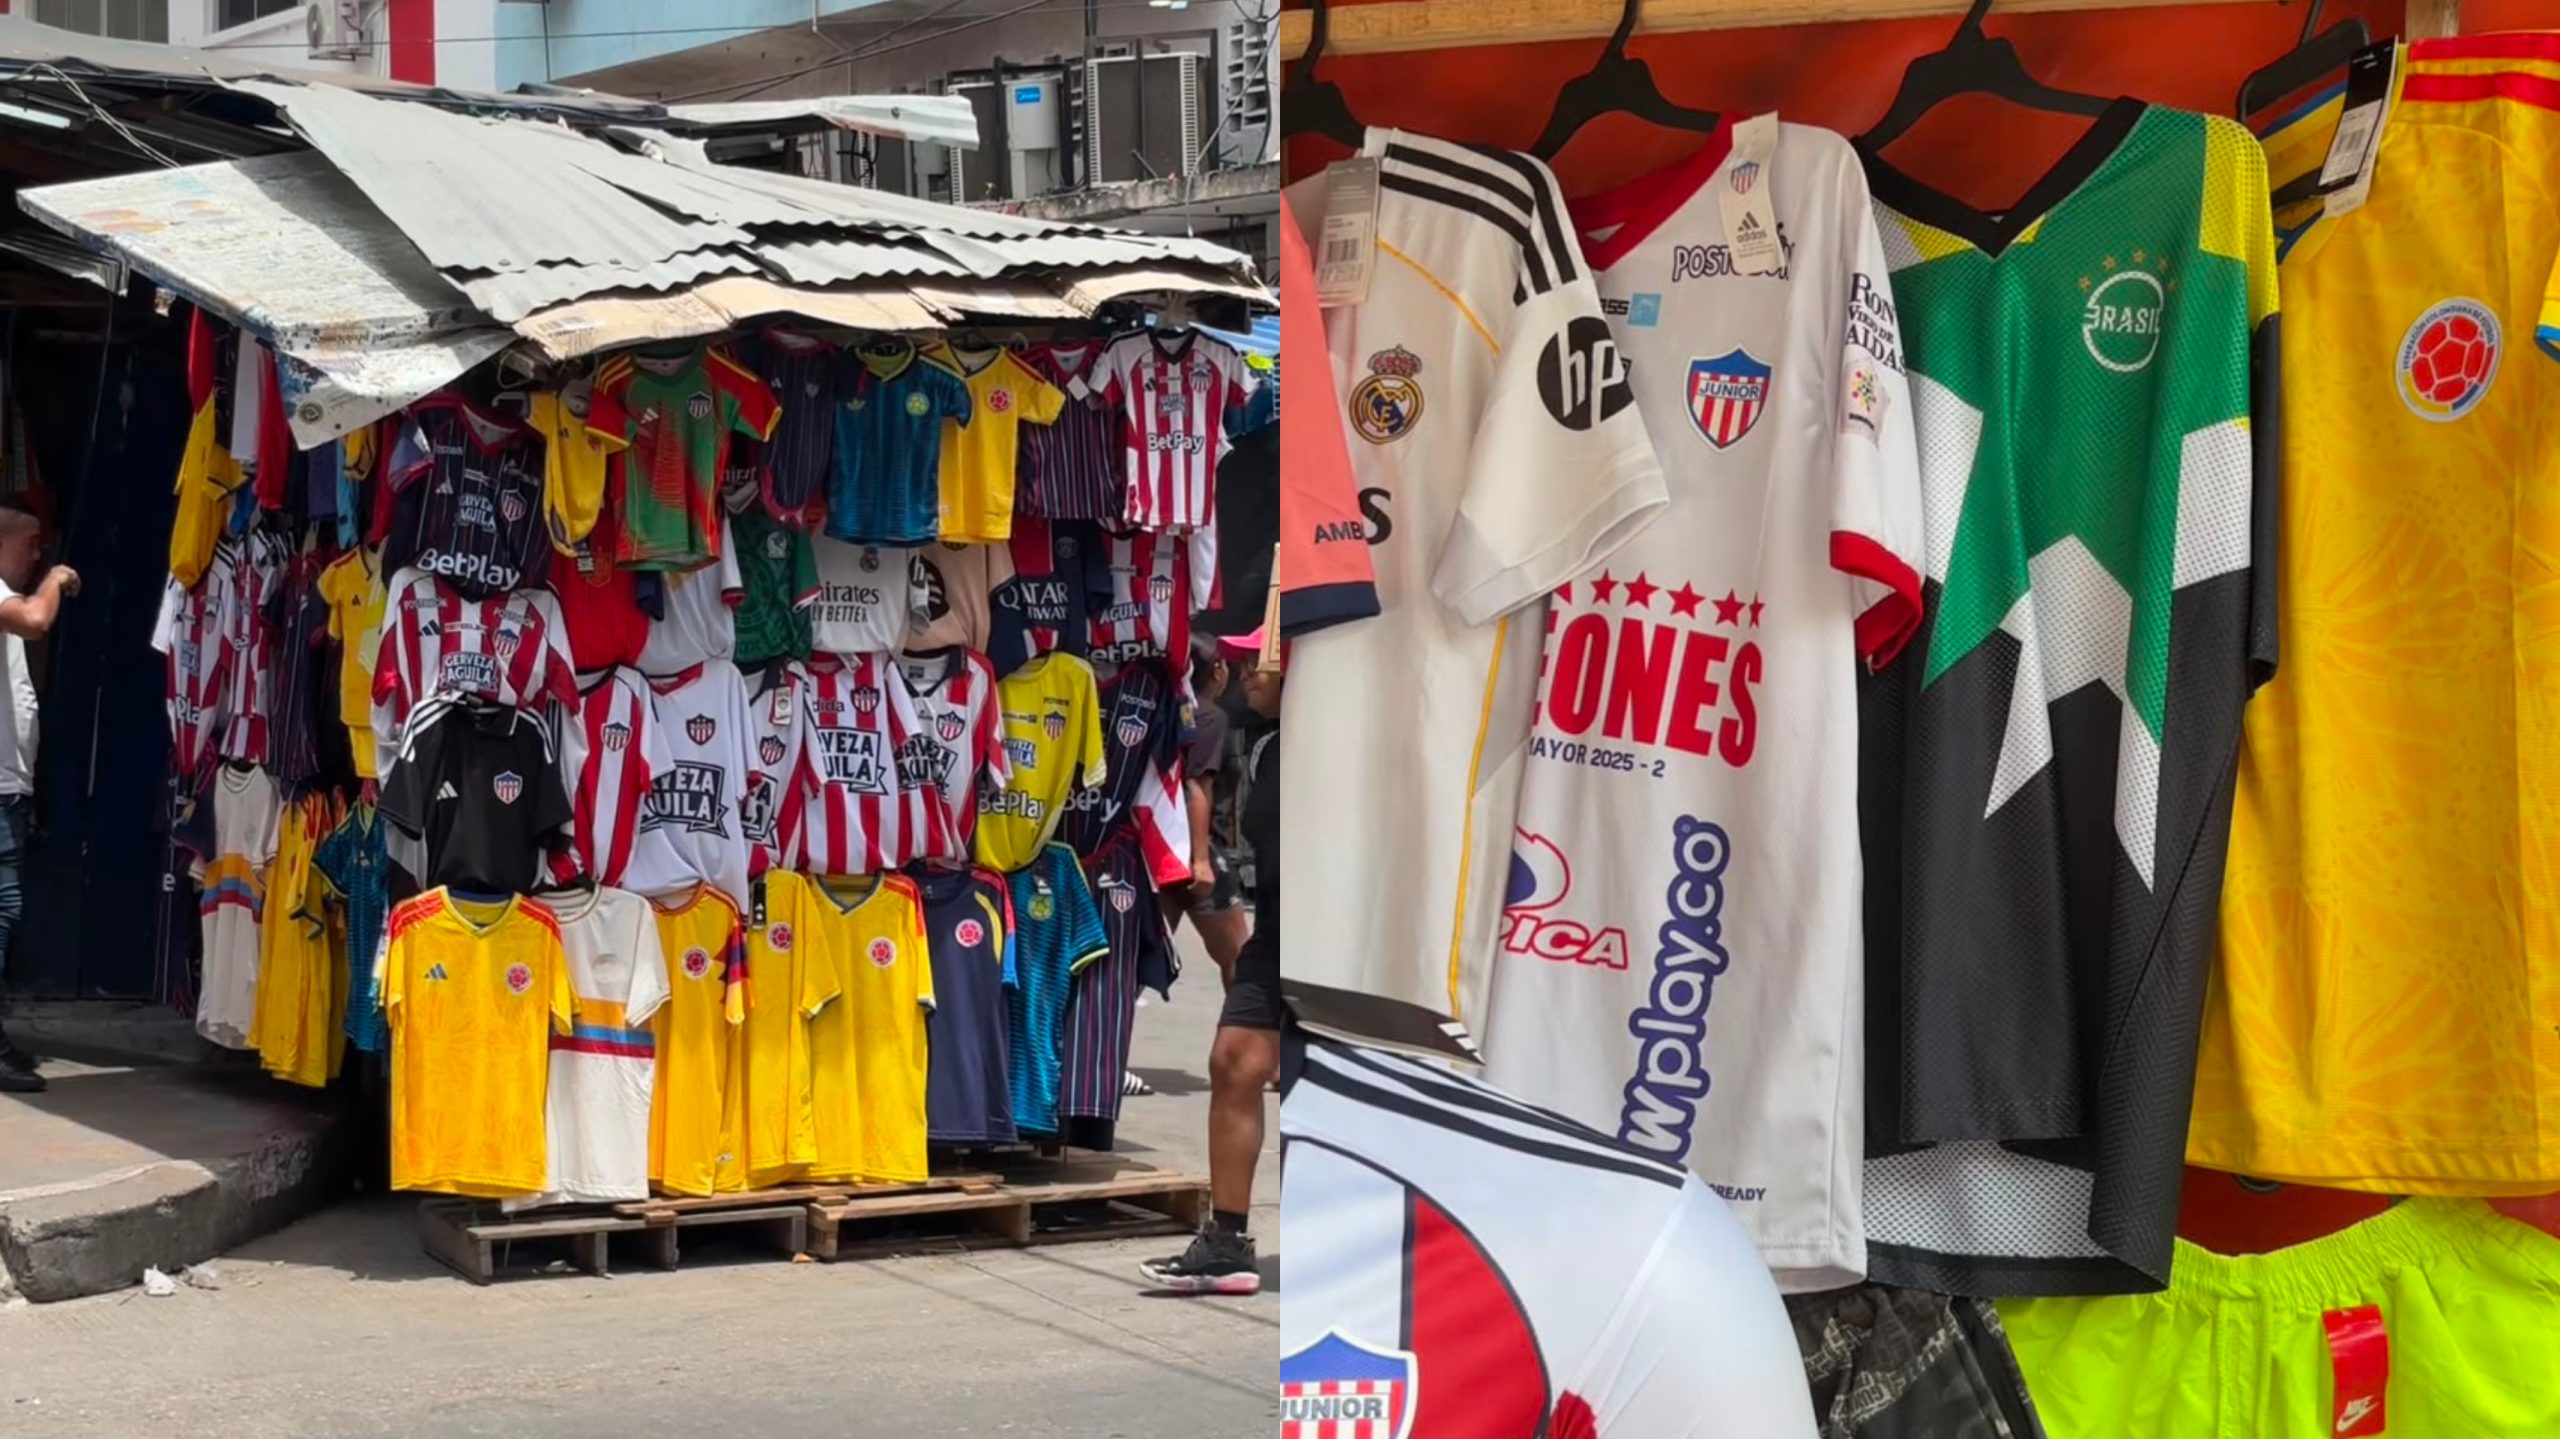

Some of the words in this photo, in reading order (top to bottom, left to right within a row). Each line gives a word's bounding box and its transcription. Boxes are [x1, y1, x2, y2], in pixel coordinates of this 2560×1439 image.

[2084, 304, 2160, 334] BRASIL
[1700, 381, 1760, 398] JUNIOR
[417, 547, 521, 592] BetPlay
[445, 653, 495, 671] CERVEZA
[446, 666, 491, 685] AGUILA
[1590, 748, 1634, 771] 2025
[1652, 758, 1667, 778] 2
[1622, 824, 1727, 1160] wplay.co
[1280, 1397, 1383, 1420] JUNIOR
